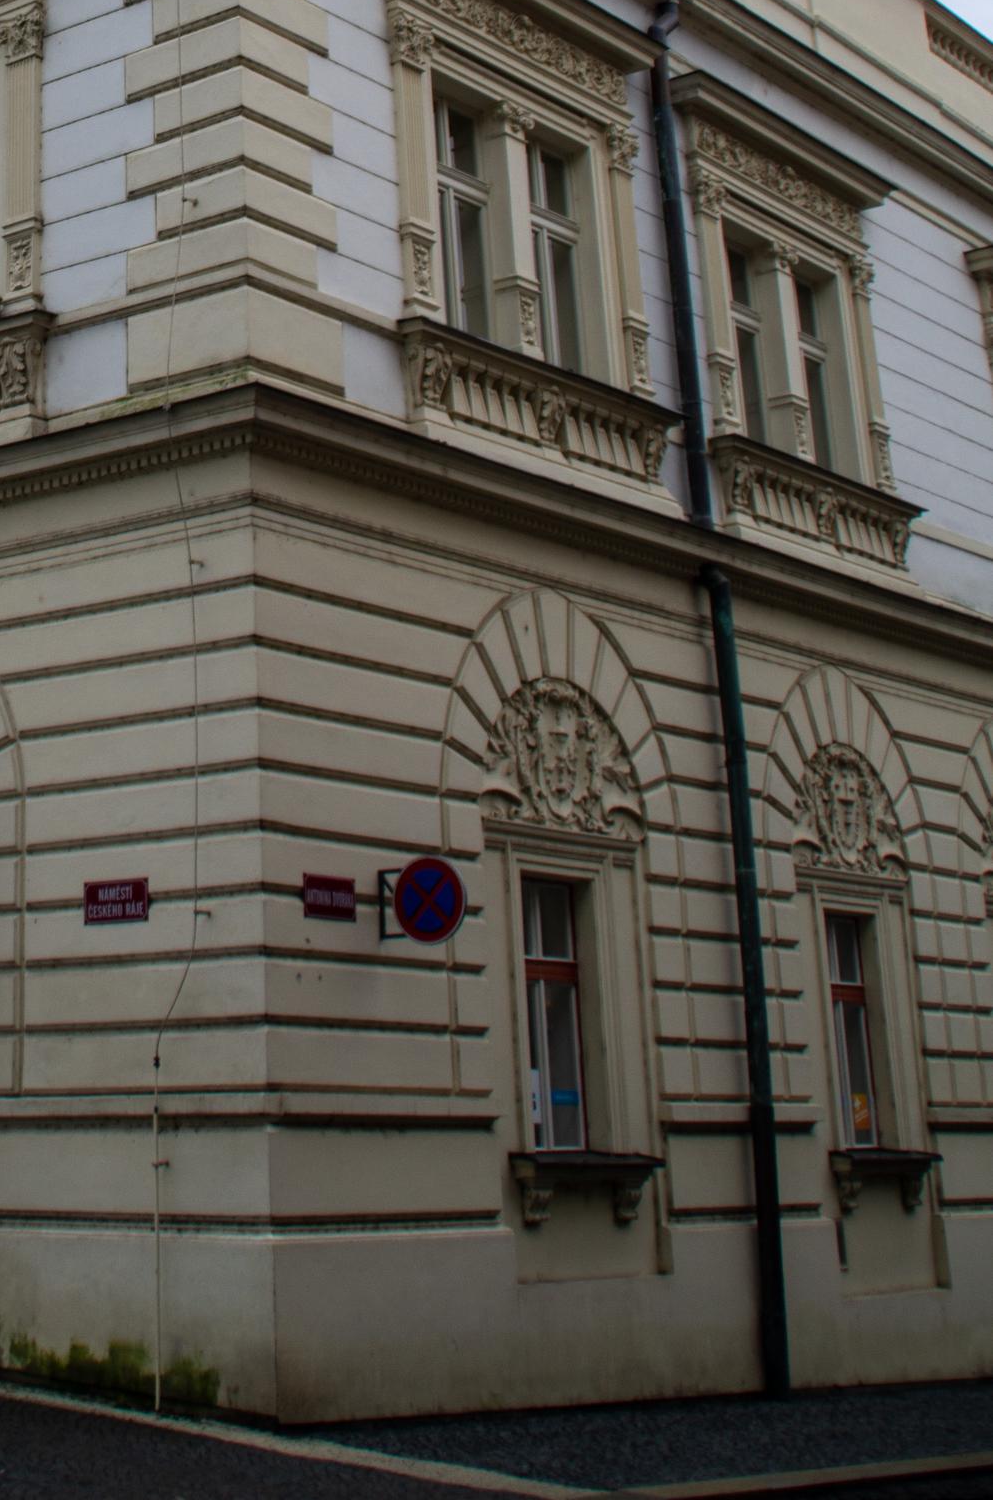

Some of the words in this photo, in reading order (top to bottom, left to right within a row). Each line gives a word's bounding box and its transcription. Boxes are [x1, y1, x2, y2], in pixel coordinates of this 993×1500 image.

[98, 884, 133, 902] NÁMĚSTÍ
[88, 902, 123, 918] ČESKÉHO
[125, 900, 144, 917] RÁJE
